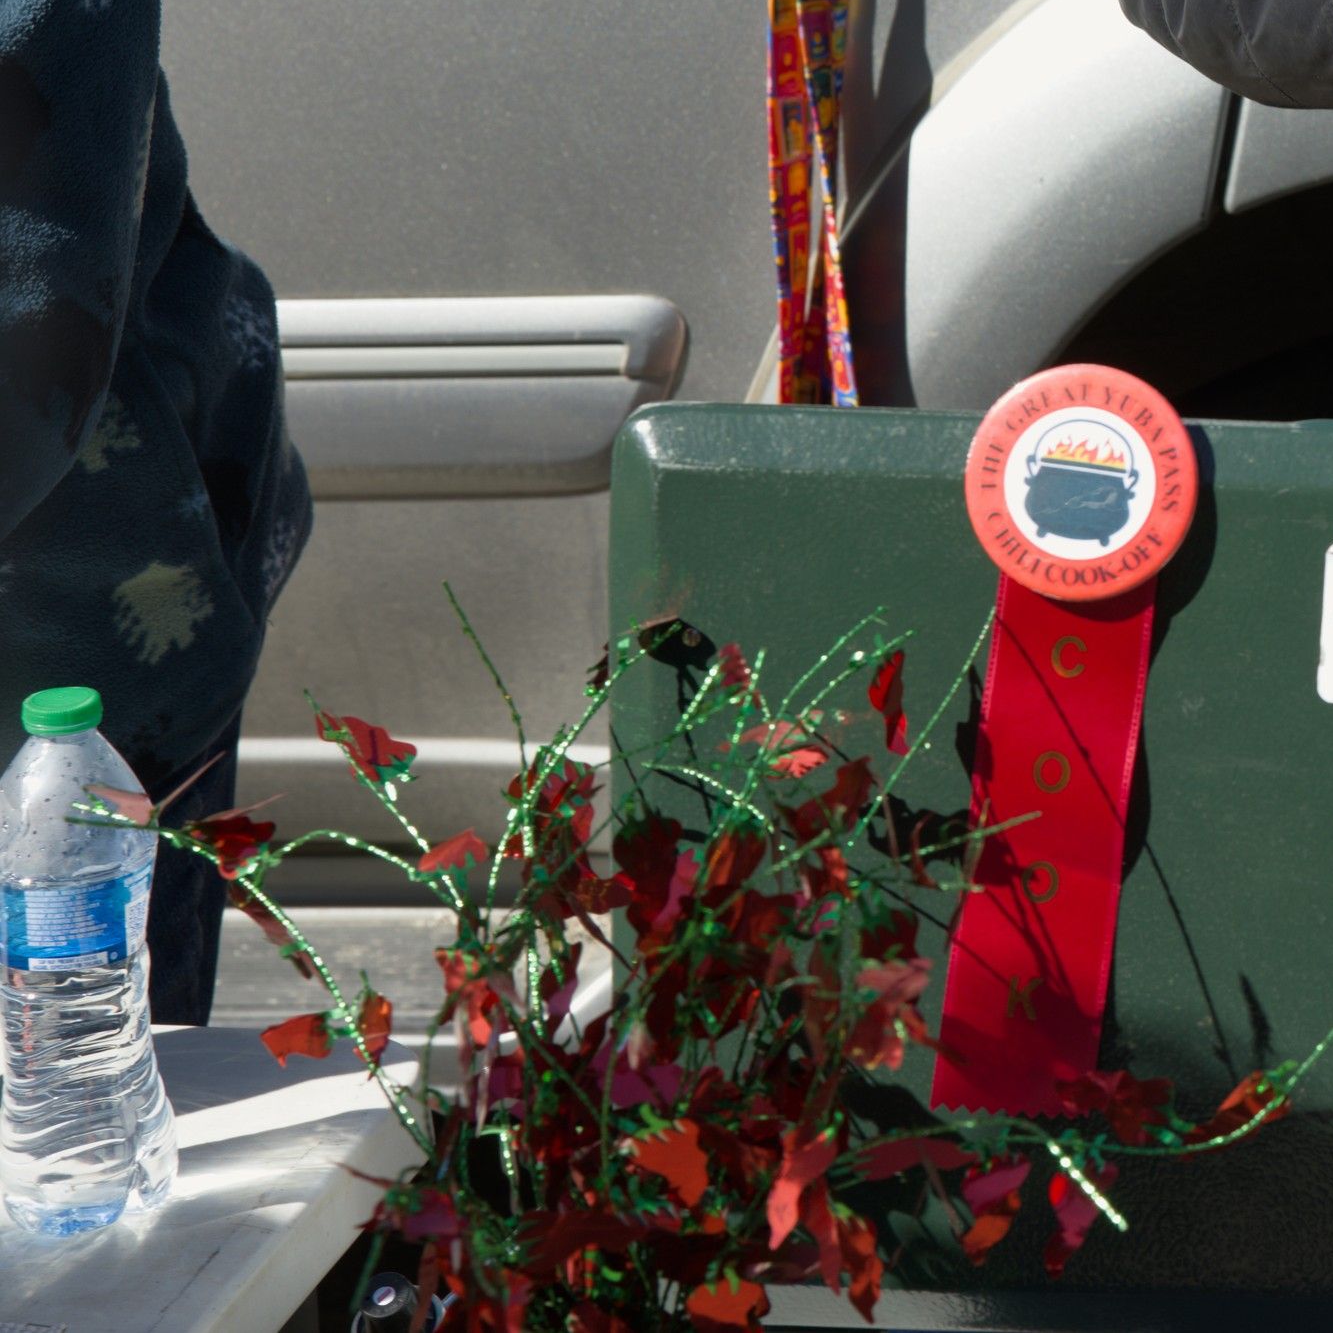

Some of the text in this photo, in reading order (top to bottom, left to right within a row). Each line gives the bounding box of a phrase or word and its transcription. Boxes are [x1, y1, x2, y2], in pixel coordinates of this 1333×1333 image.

[980, 383, 1183, 514] THE GREAT YUBA PASS
[986, 511, 1164, 587] CHILI COOK-OFF
